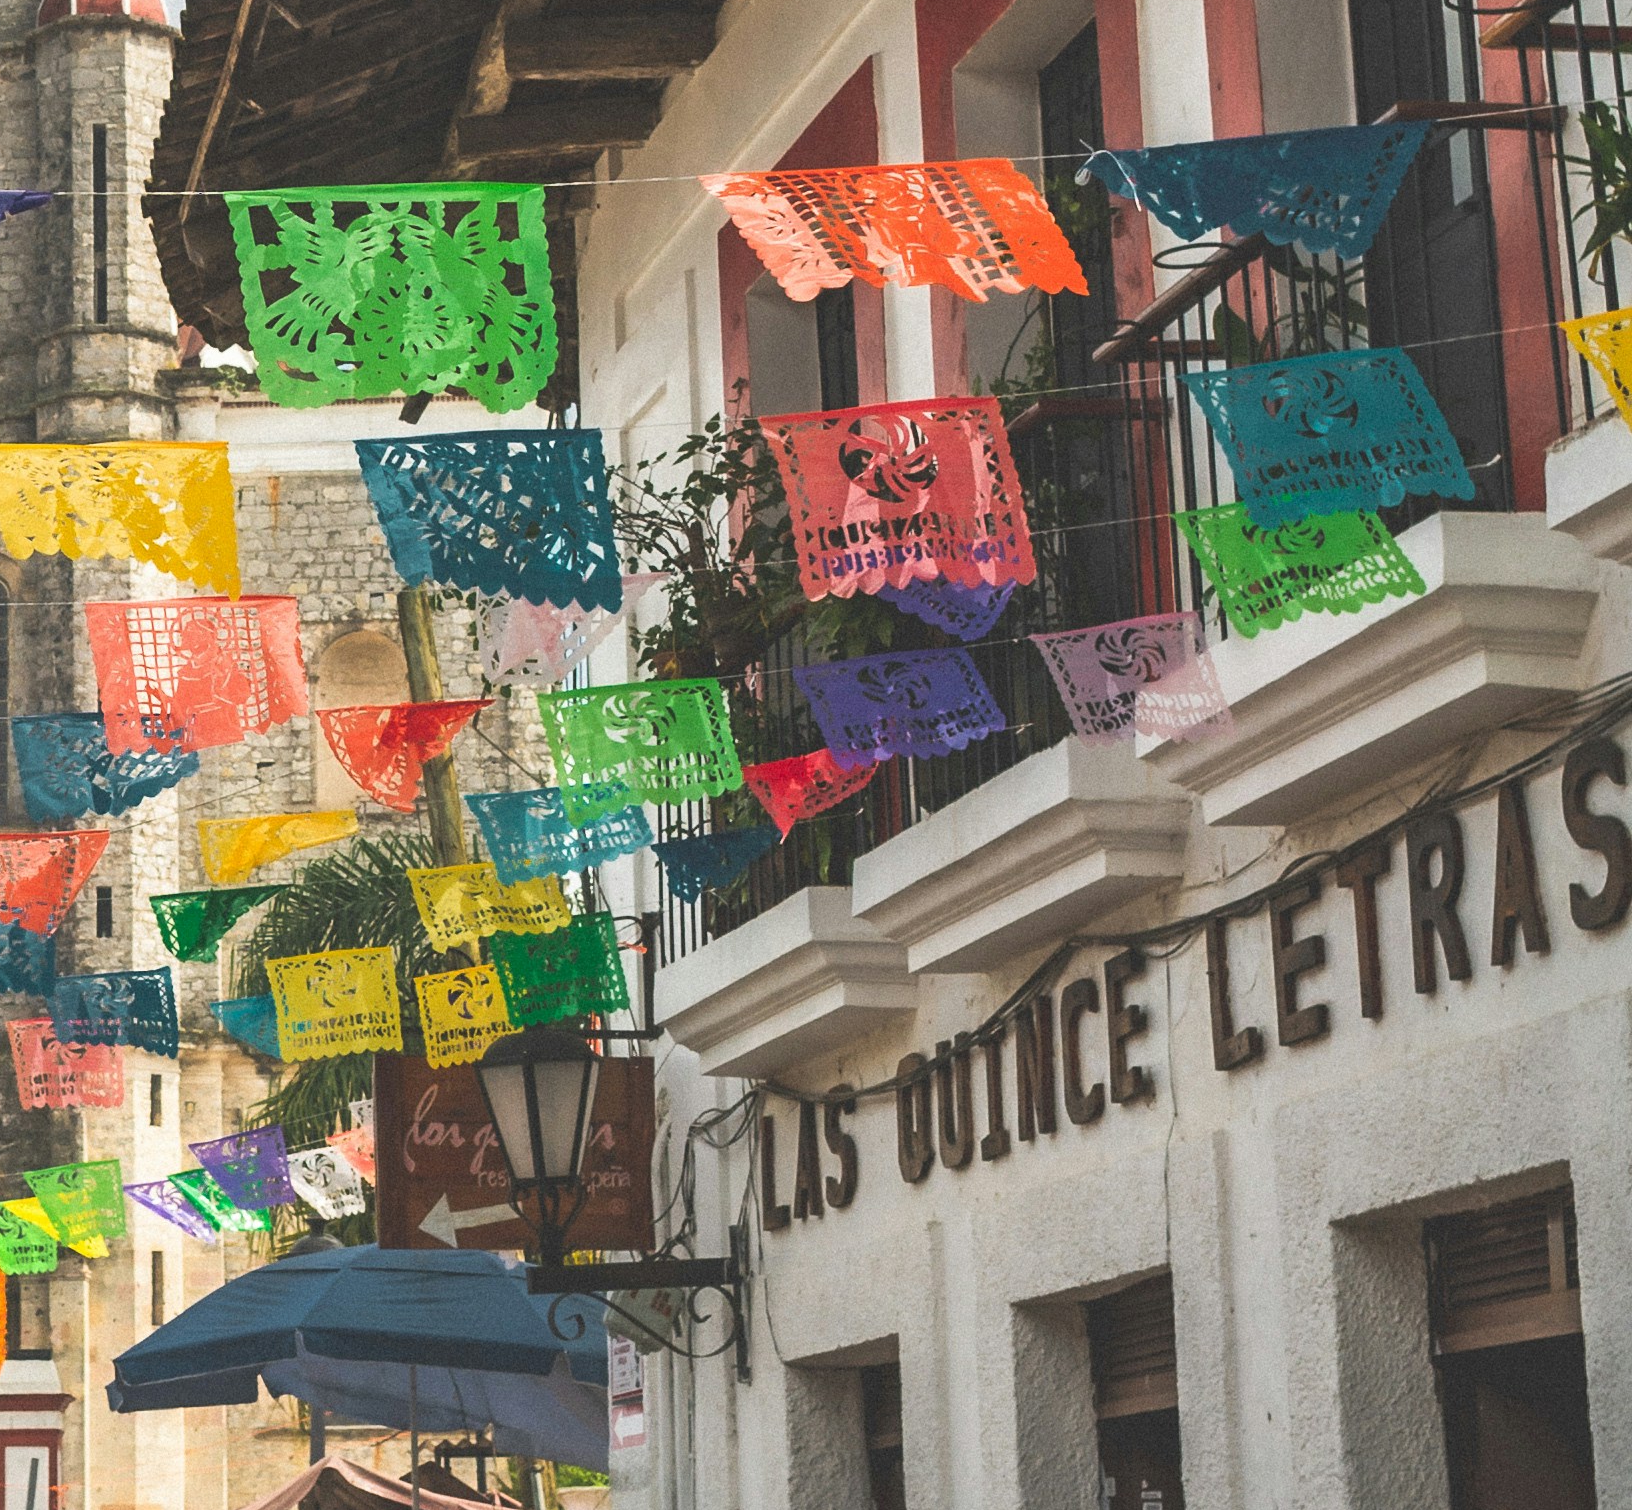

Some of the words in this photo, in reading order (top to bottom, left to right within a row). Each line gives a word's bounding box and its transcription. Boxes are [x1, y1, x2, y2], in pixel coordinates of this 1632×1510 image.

[761, 1083, 860, 1232] LAS
[895, 947, 1156, 1184] QUINCE
[1205, 732, 1632, 1072] LETRAS
